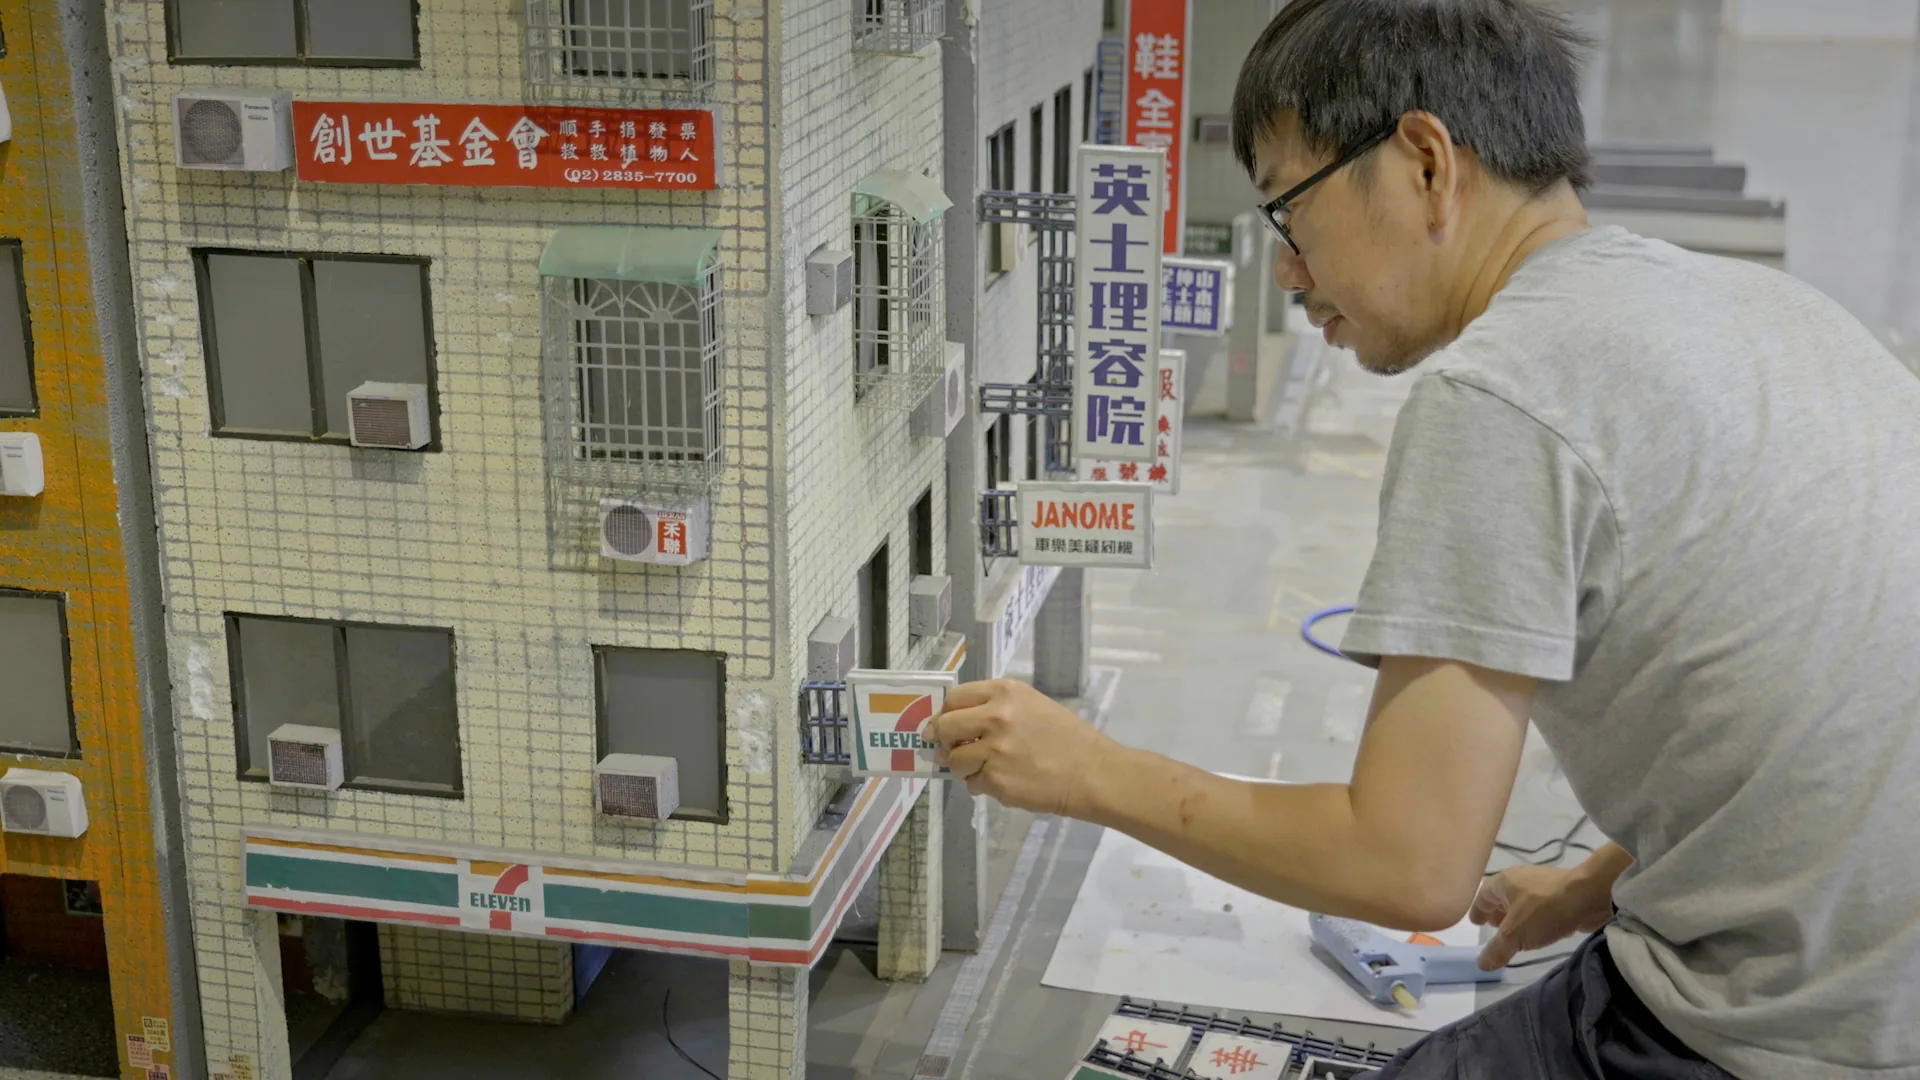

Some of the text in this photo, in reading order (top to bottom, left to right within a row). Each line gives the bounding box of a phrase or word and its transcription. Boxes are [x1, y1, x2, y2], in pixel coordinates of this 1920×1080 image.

[309, 113, 549, 170] 創世基金會
[559, 119, 697, 141] 順手捐發票
[560, 143, 699, 162] 救救植物人
[1087, 163, 1151, 446] 英士理容院
[1032, 500, 1135, 530] JANOME
[1034, 537, 1133, 555] 車樂美縫紉機
